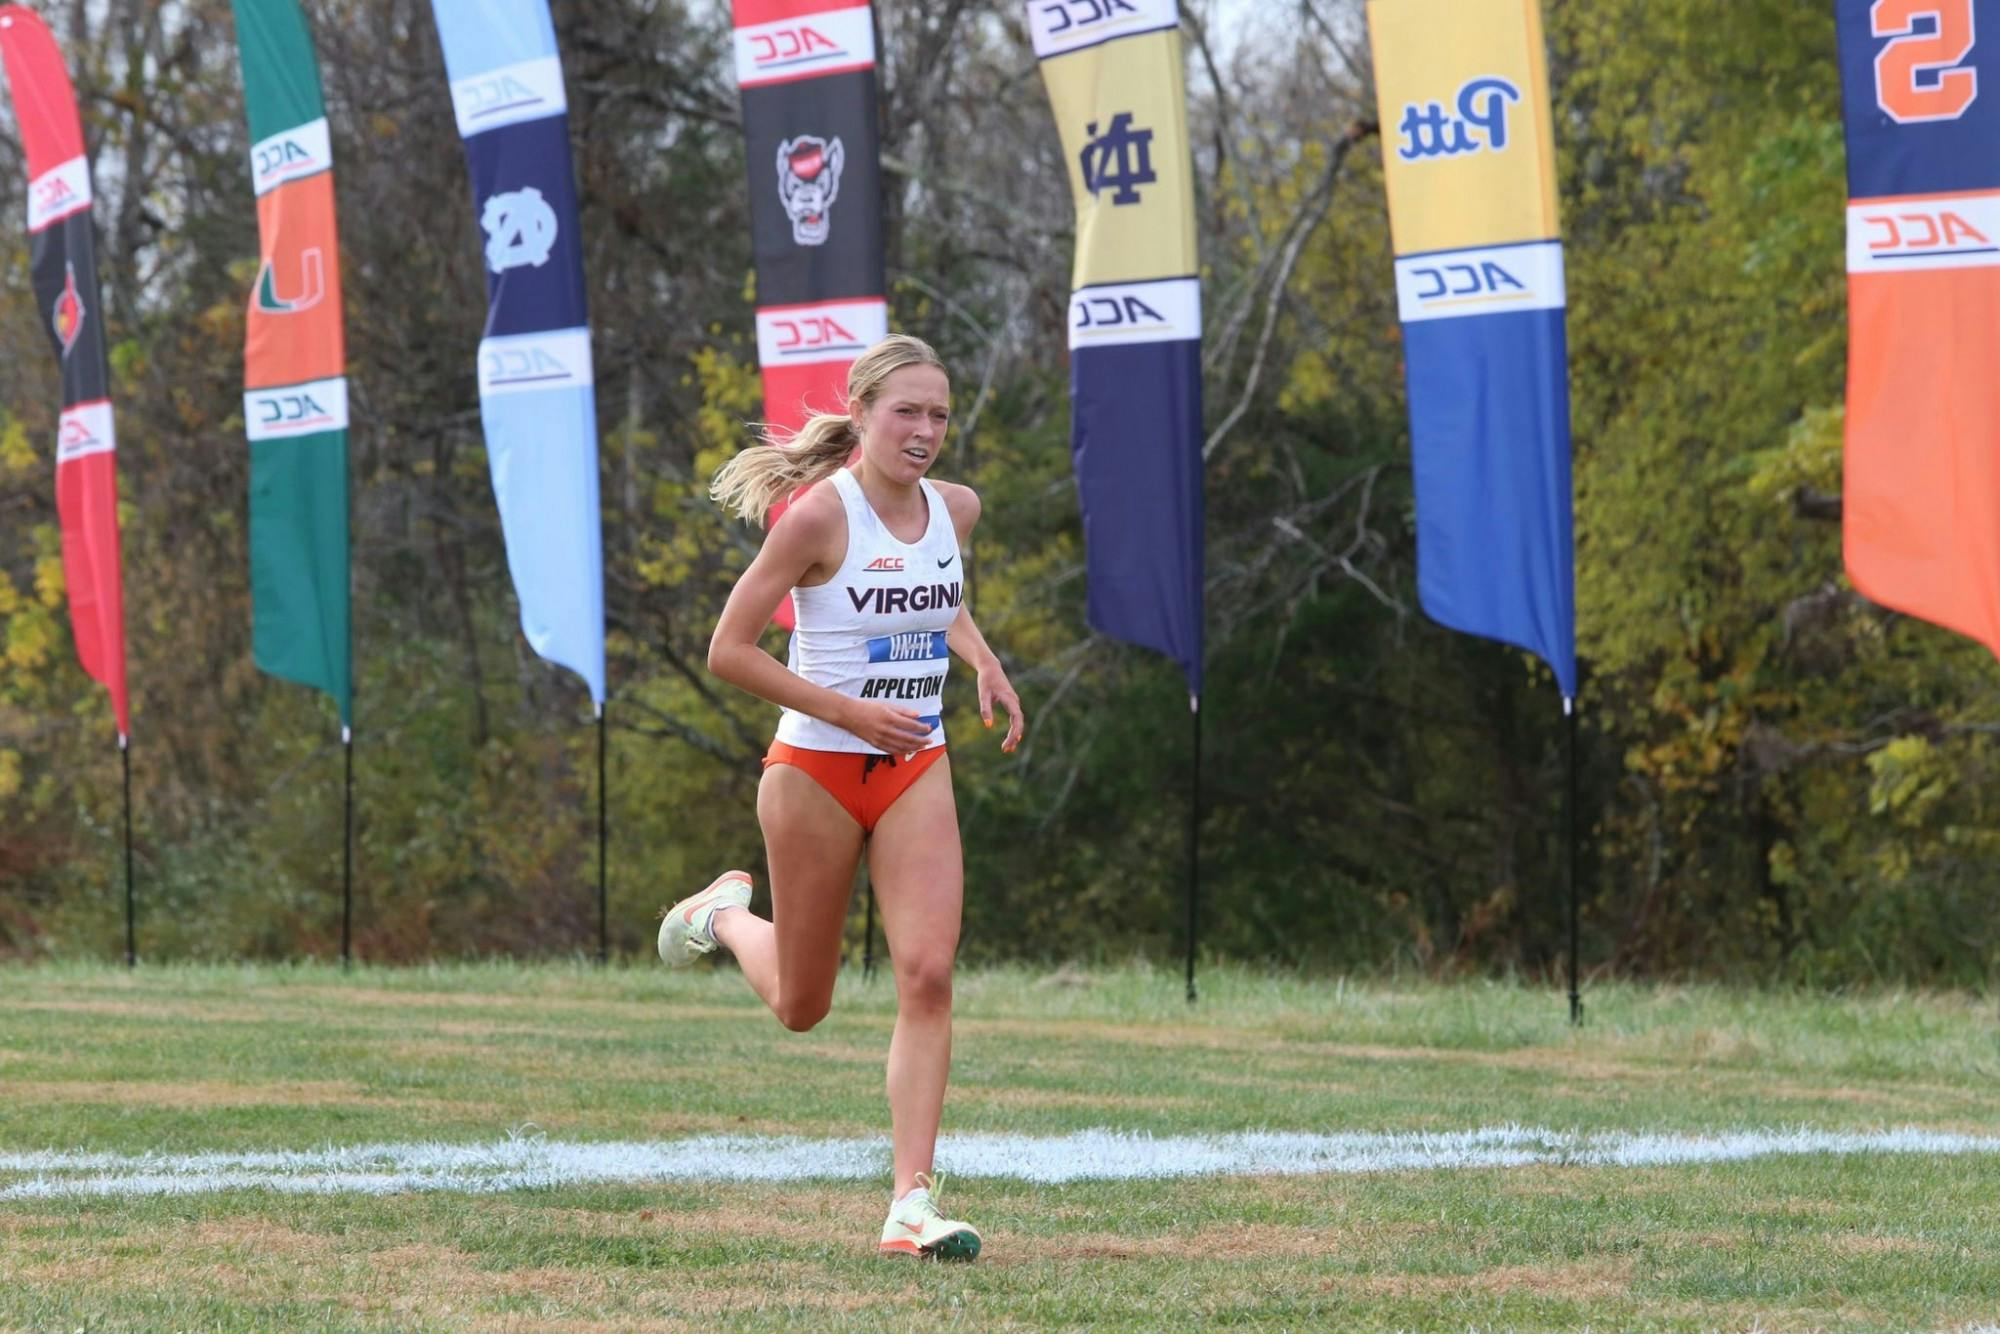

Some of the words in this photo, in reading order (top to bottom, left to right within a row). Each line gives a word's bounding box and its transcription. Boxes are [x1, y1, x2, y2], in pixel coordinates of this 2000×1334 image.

[867, 558, 904, 569] ACC
[847, 582, 962, 614] VIRGINI
[889, 632, 933, 660] UNITE
[860, 675, 942, 699] APPLETON
